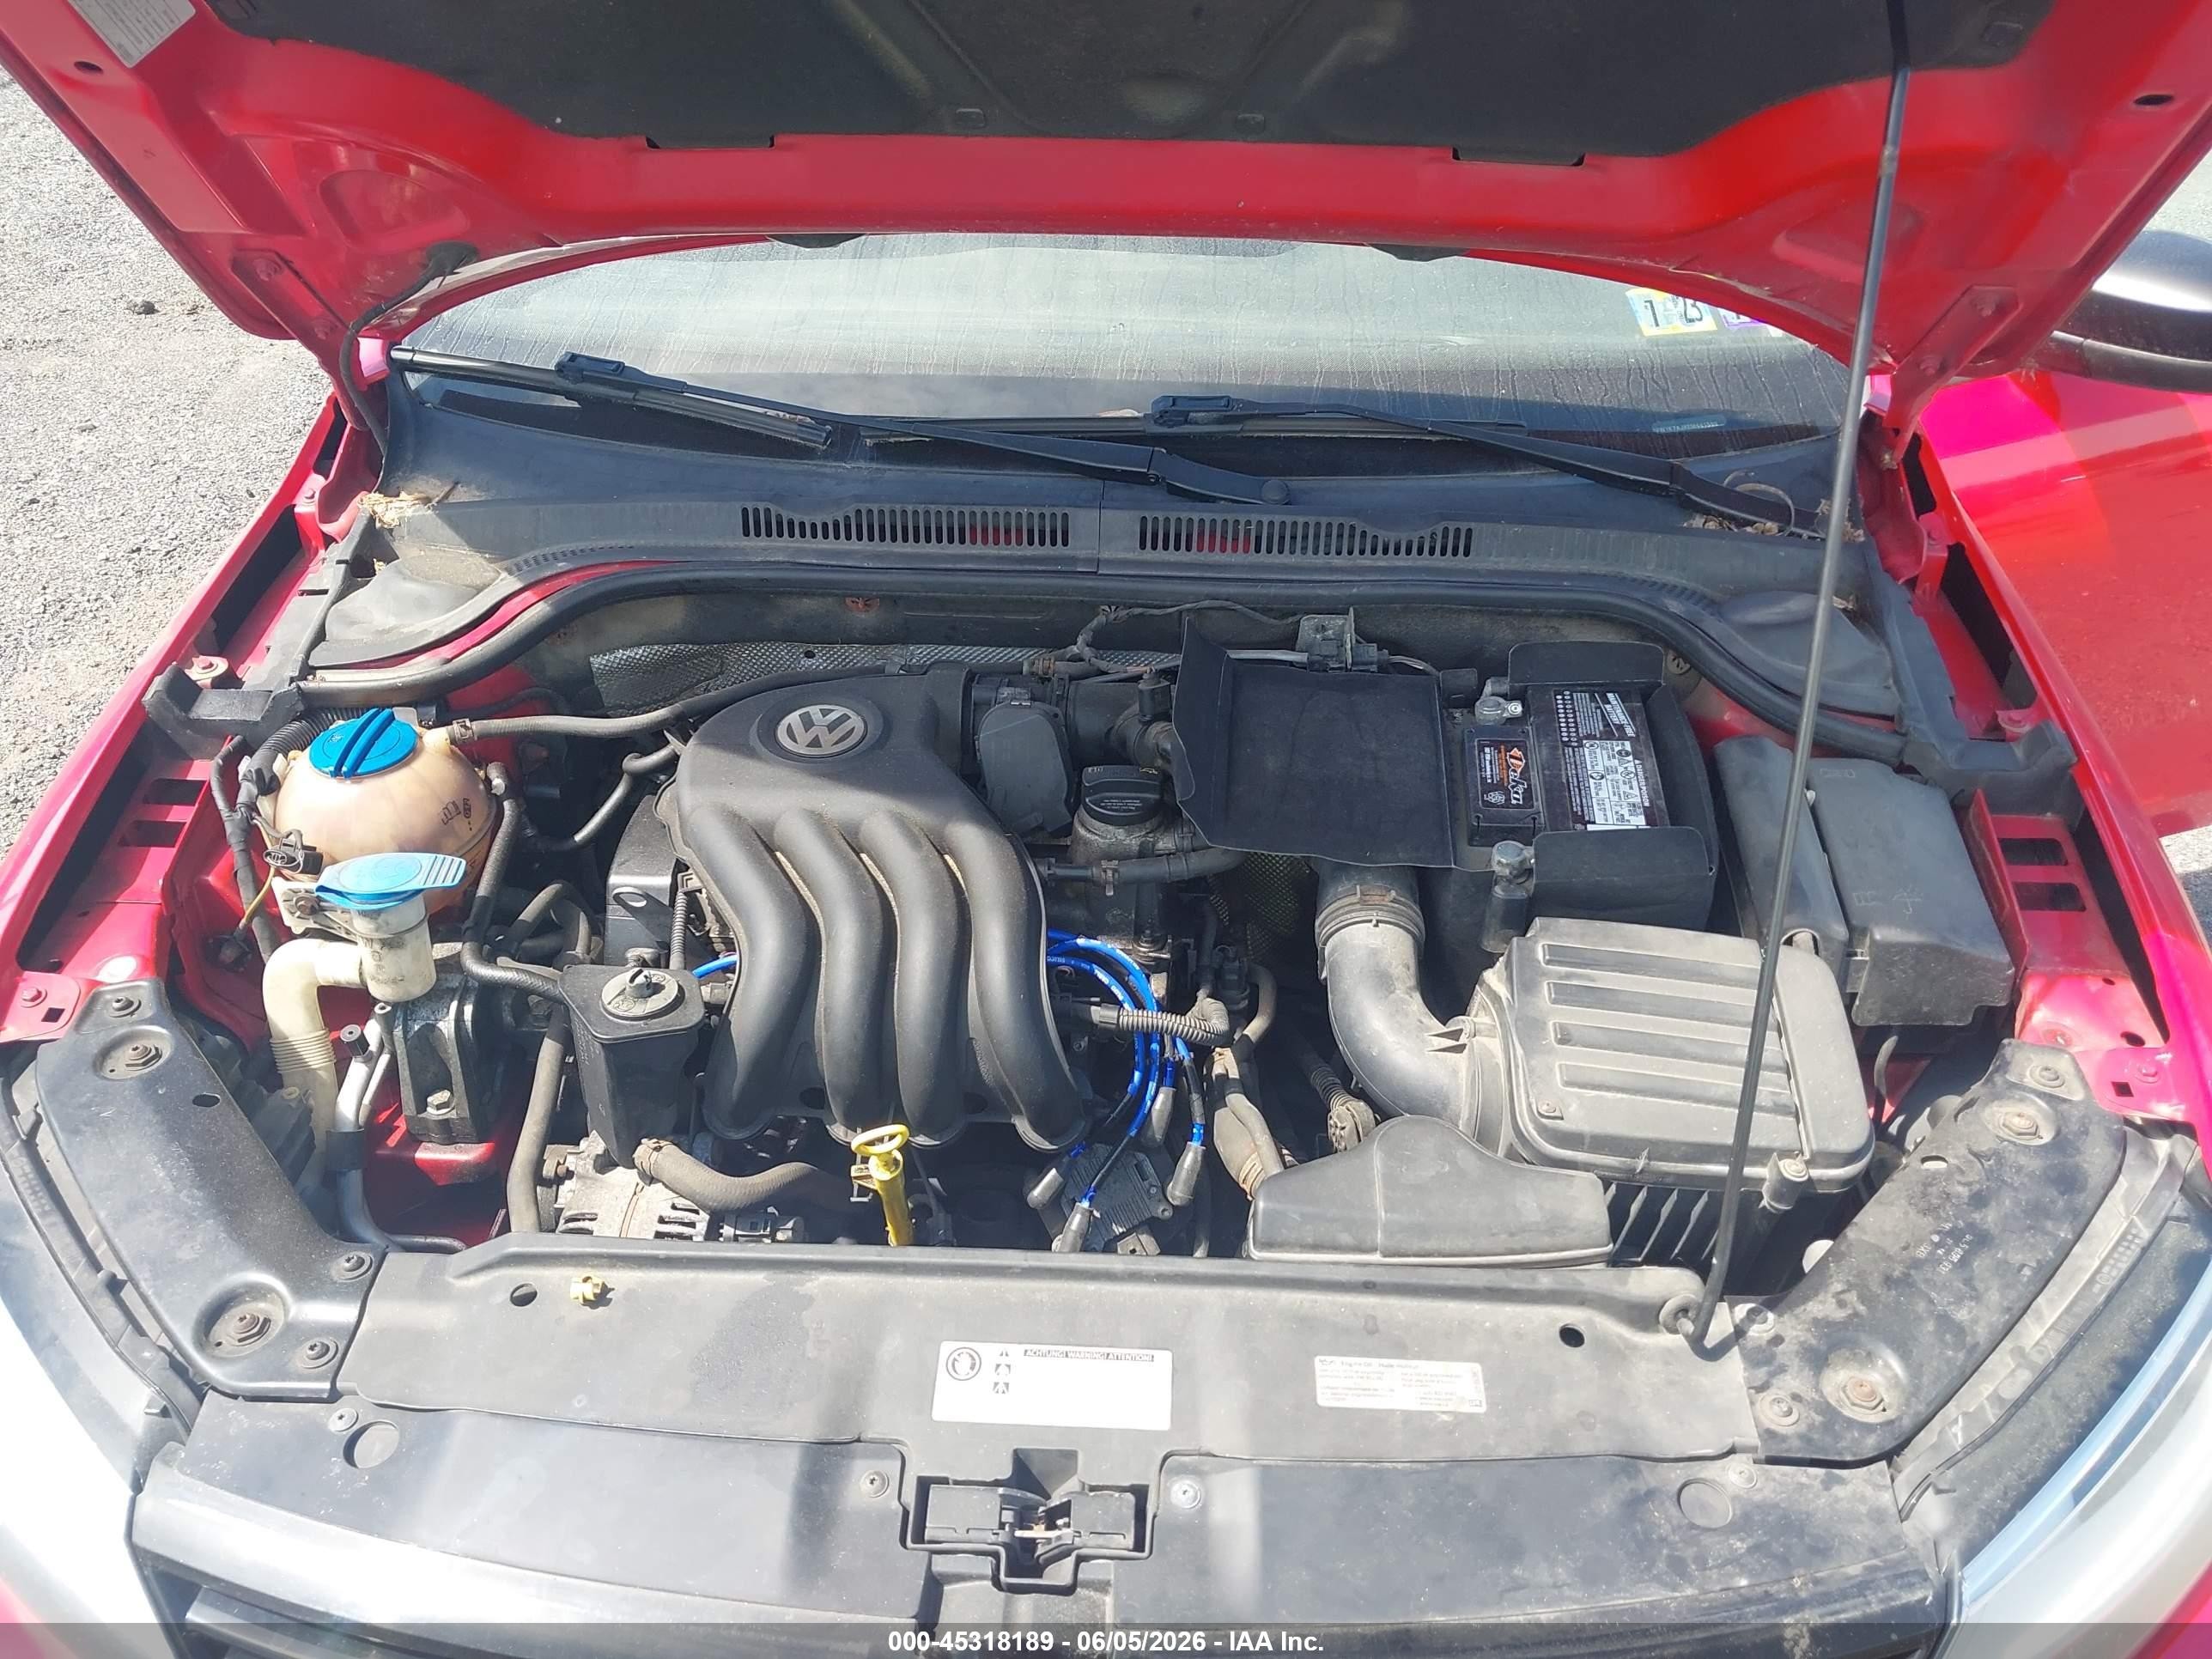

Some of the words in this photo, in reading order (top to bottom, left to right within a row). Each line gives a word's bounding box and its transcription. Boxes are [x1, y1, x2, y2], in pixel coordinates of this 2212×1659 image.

[777, 704, 865, 756] VW
[1506, 747, 1528, 805] Deka
[1025, 1349, 1066, 1358] ACHTUNG!
[1067, 1350, 1106, 1360] WARNING!
[1108, 1352, 1152, 1362] ATTENTION!
